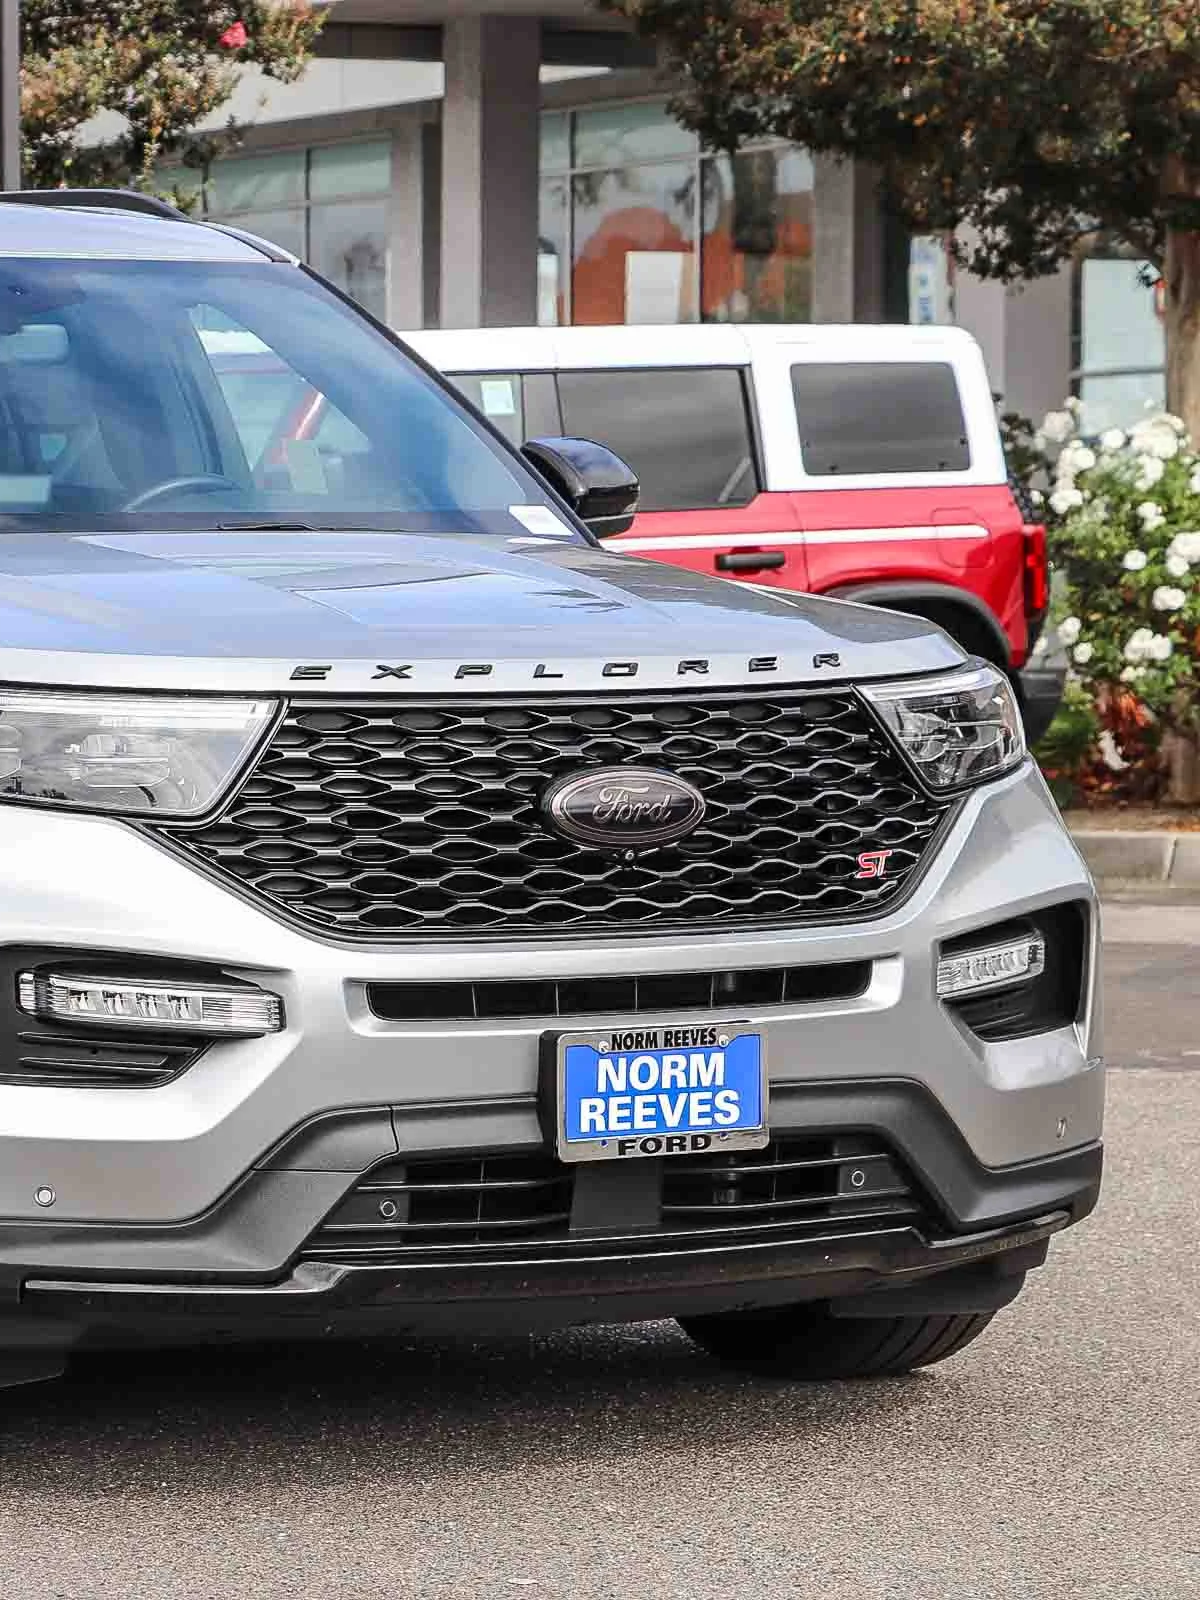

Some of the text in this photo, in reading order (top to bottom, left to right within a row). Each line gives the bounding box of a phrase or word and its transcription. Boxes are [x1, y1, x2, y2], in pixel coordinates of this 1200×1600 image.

[289, 653, 842, 681] EXPLORER
[592, 786, 672, 822] Ford
[855, 850, 893, 878] ST
[611, 1027, 717, 1051] NORM REEVES
[597, 1052, 726, 1093] NORM
[580, 1089, 740, 1133] REEVES
[617, 1134, 712, 1156] FORD
